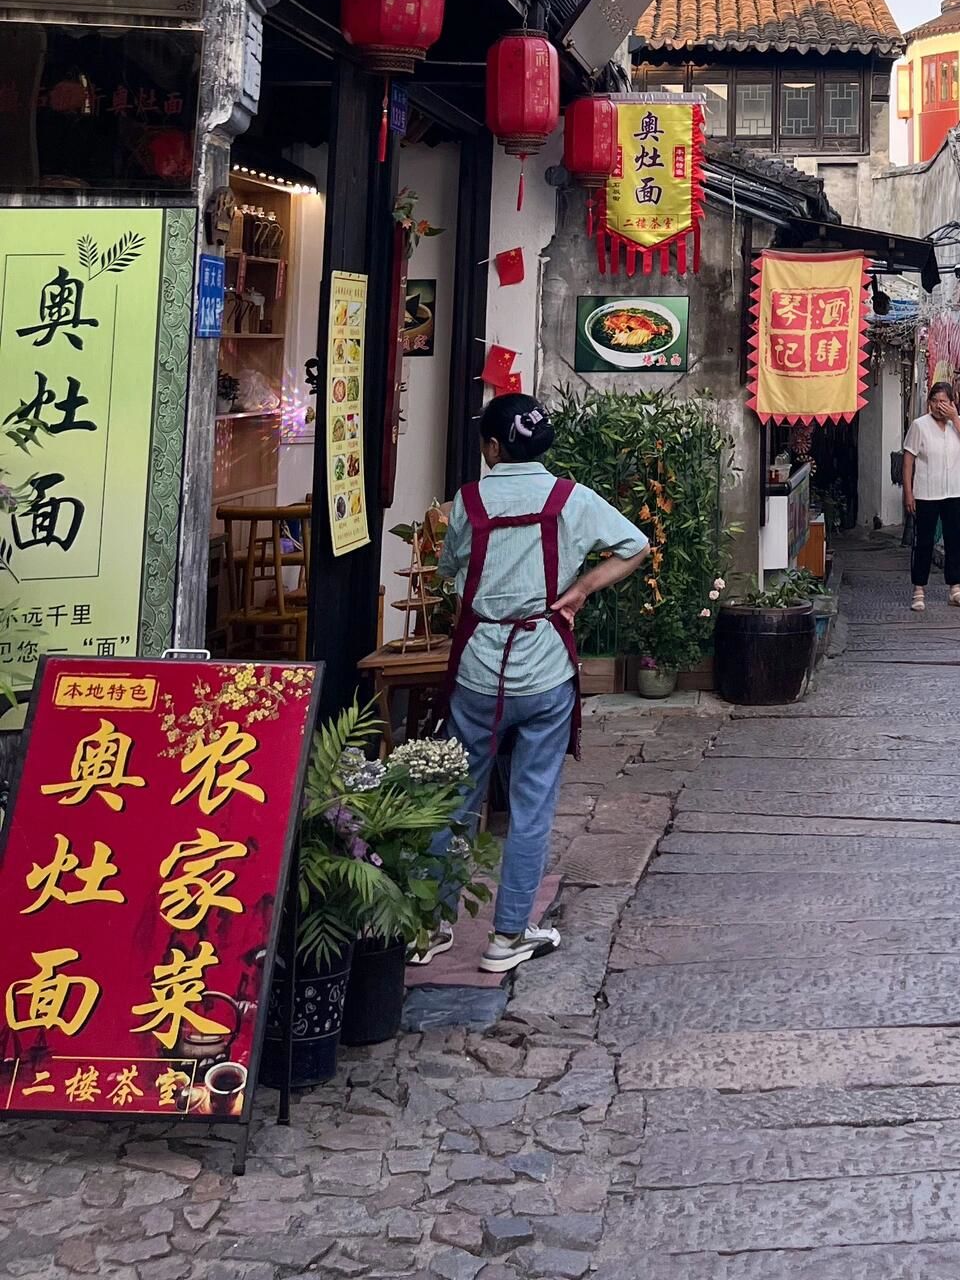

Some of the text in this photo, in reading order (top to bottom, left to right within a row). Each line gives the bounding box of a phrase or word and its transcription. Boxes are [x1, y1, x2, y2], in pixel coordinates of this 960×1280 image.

[634, 111, 665, 205] 奥灶面
[623, 217, 674, 230] 二楼茶室
[11, 265, 100, 552] 奥灶面
[0, 604, 92, 628] 不远千里
[63, 681, 149, 703] 本地特色
[5, 718, 145, 1036] 奥灶面
[130, 721, 266, 1051] 农家菜
[22, 1064, 191, 1107] 二楼茶室
